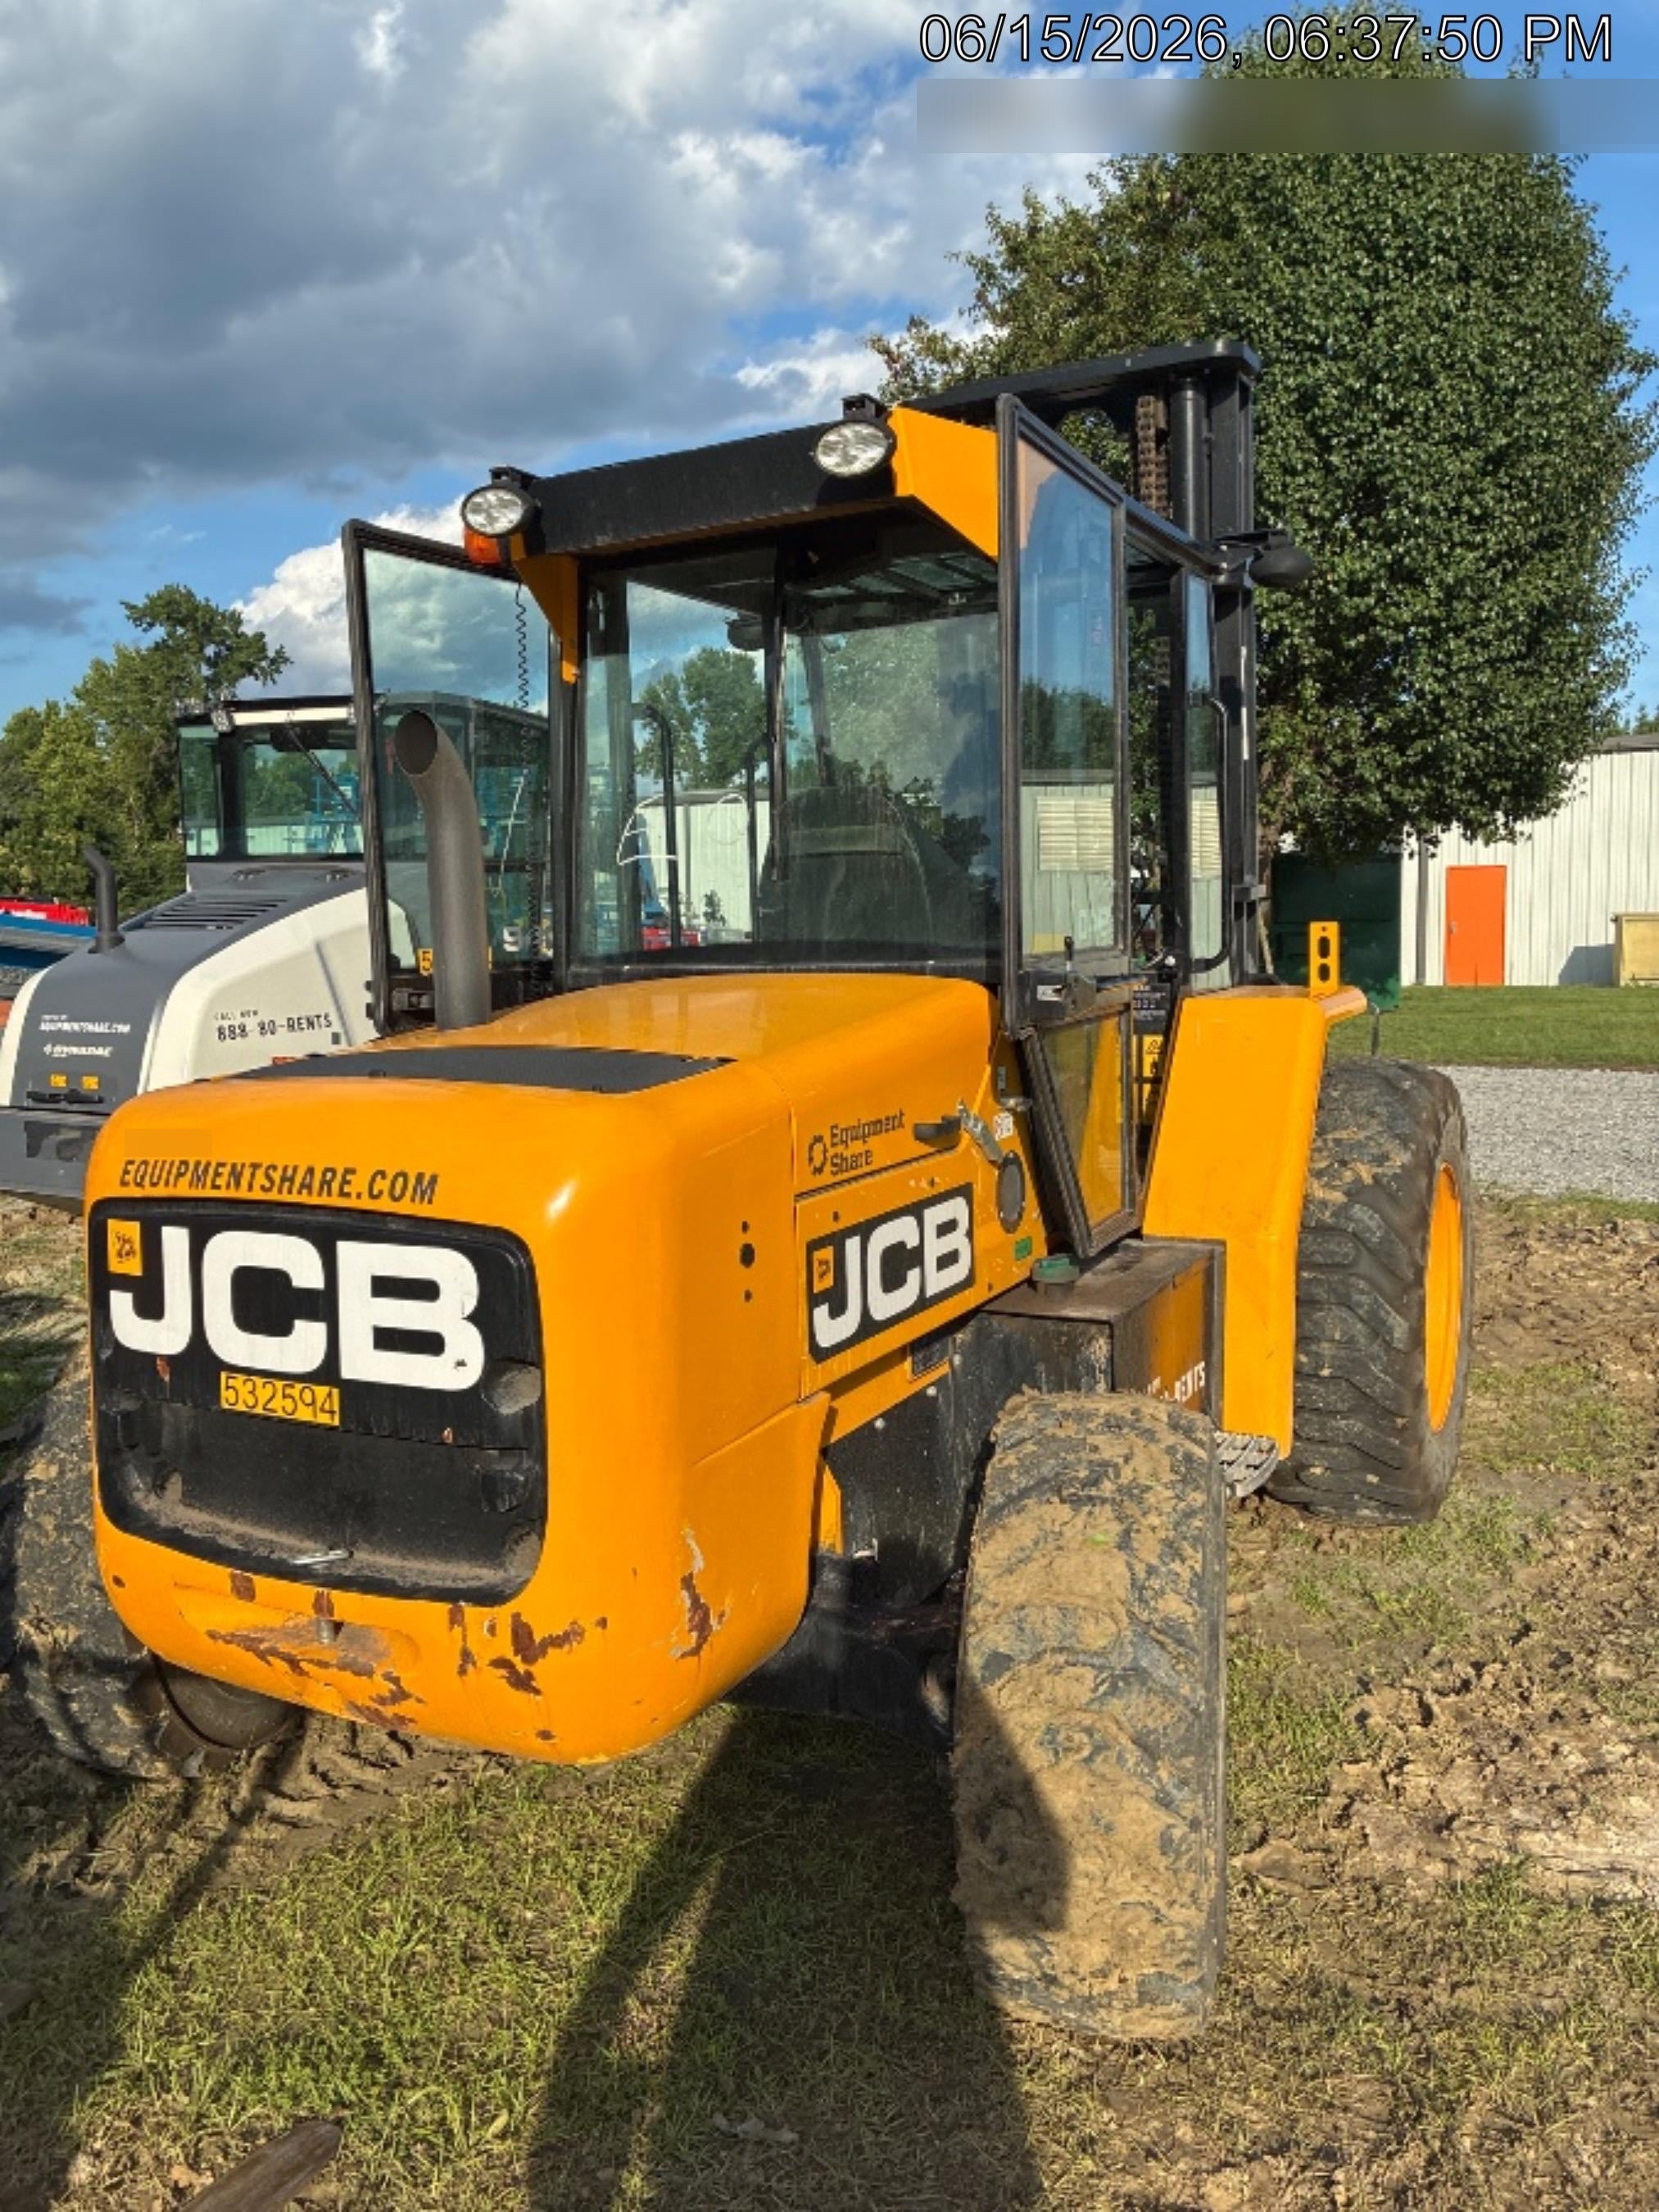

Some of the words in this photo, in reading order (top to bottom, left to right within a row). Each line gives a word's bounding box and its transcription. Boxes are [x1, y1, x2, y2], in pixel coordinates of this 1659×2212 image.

[828, 1108, 906, 1151] Equipment
[119, 1158, 439, 1207] EQUIPMENTSHARE.COM
[828, 1149, 873, 1178] Share
[812, 1195, 973, 1349] JCB
[109, 1225, 486, 1393] JCB
[224, 1375, 338, 1423] 532594
